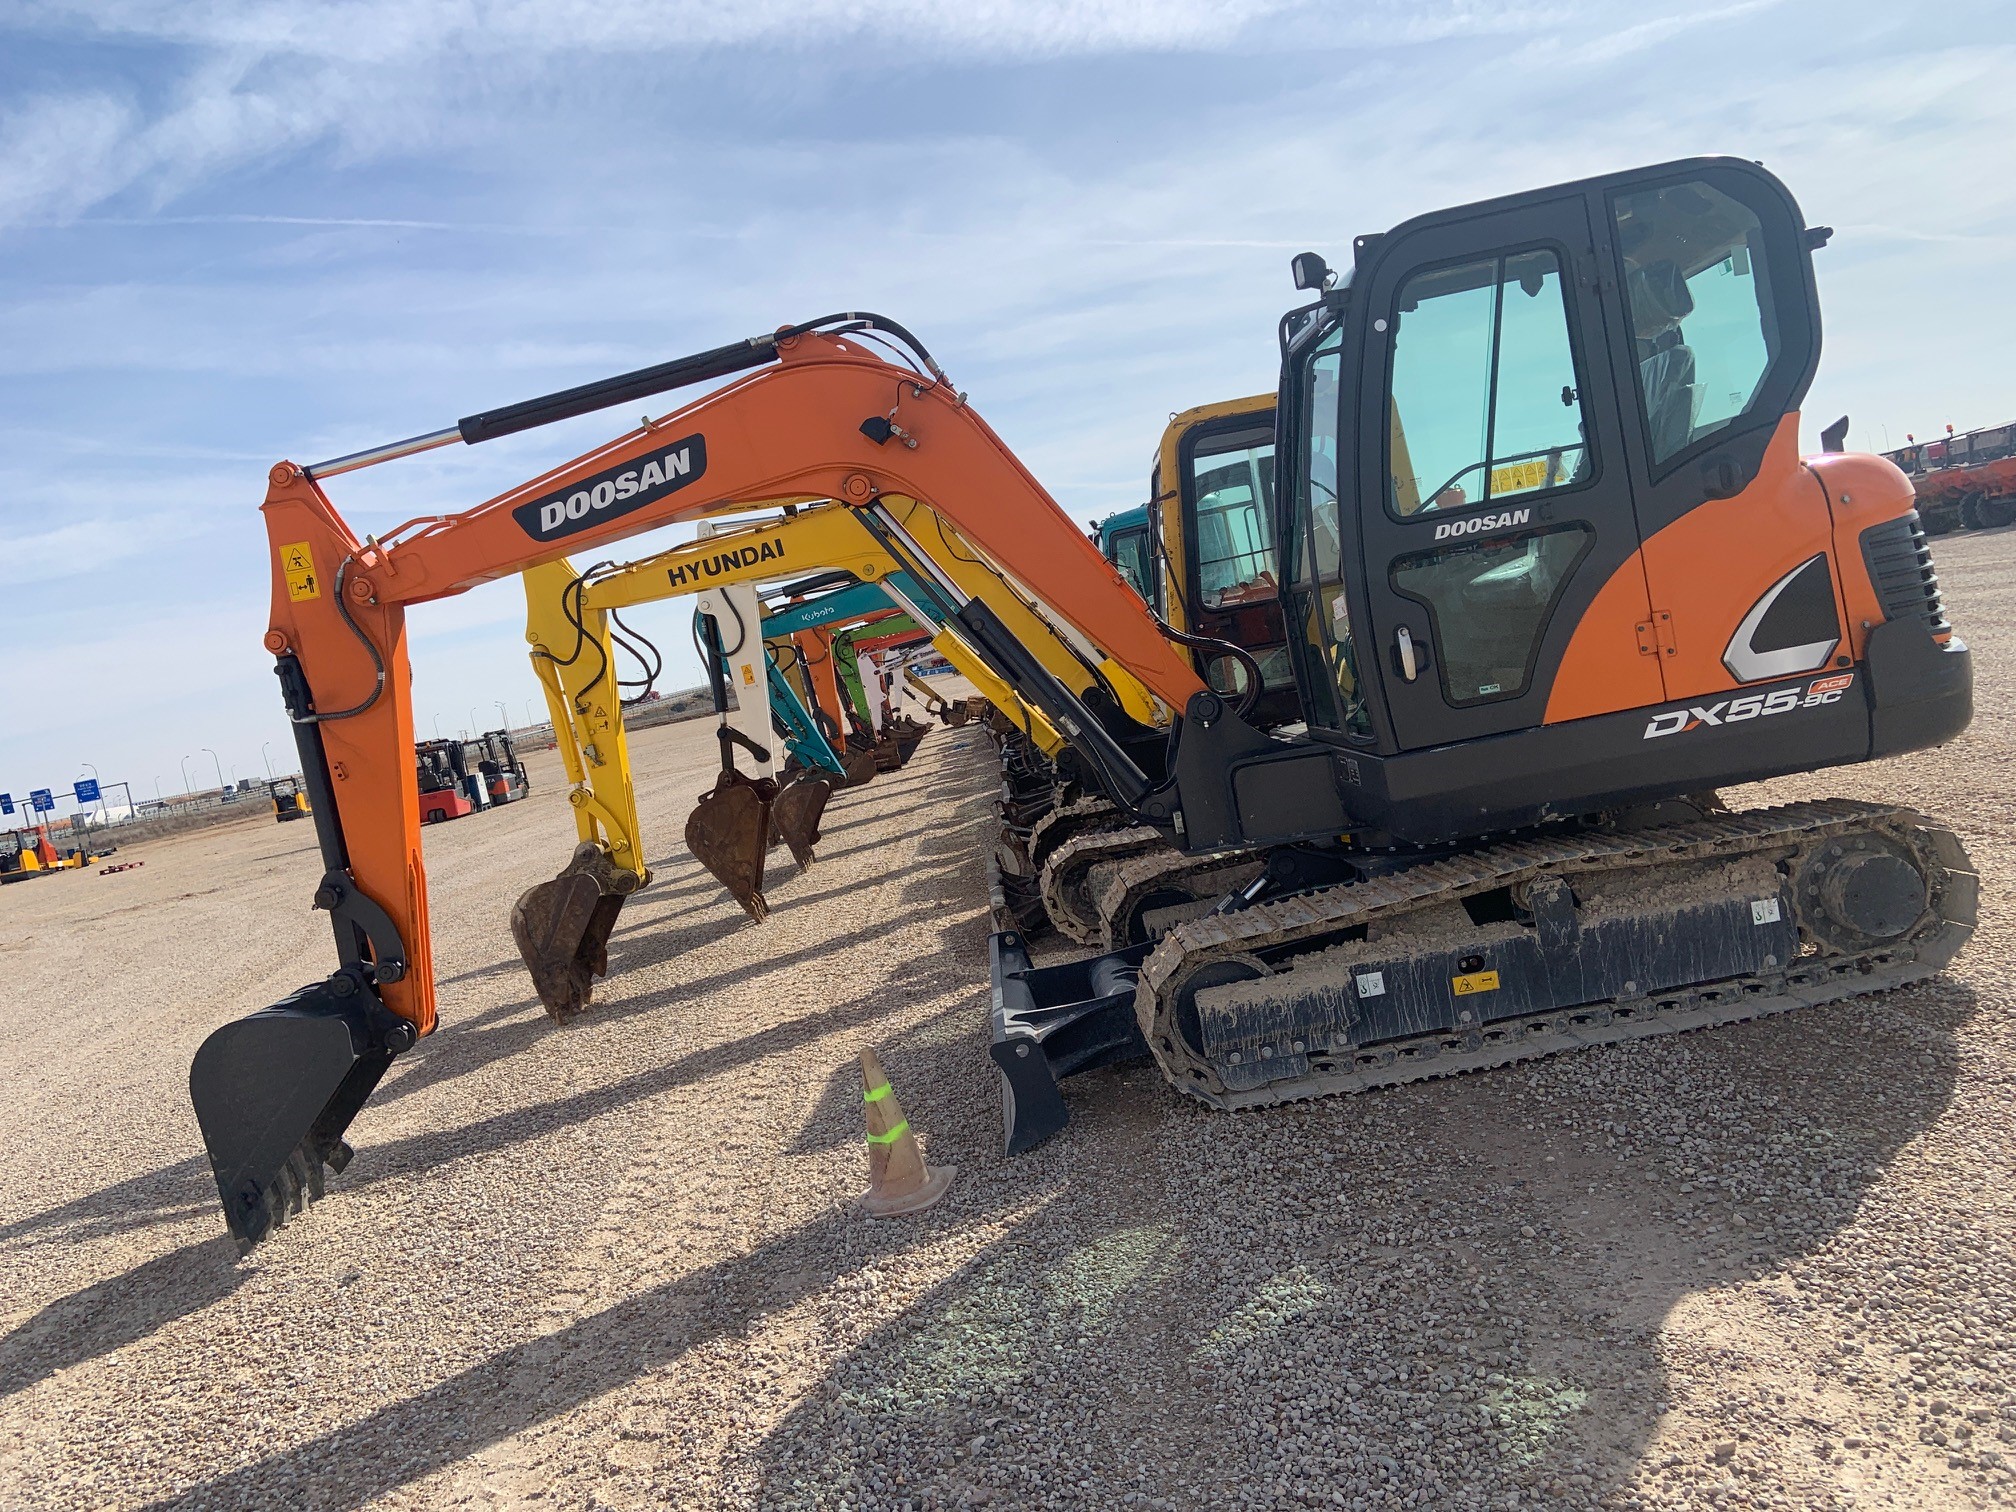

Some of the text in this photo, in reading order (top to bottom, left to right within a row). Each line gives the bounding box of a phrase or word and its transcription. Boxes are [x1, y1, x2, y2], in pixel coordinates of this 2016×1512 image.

[540, 447, 691, 533] DOOSAN
[1434, 508, 1530, 540] DOOSAN
[667, 538, 786, 587] HYUNDAI
[801, 606, 835, 622] Kubota
[1817, 678, 1849, 691] ACE
[1643, 687, 1843, 740] DX55-9C
